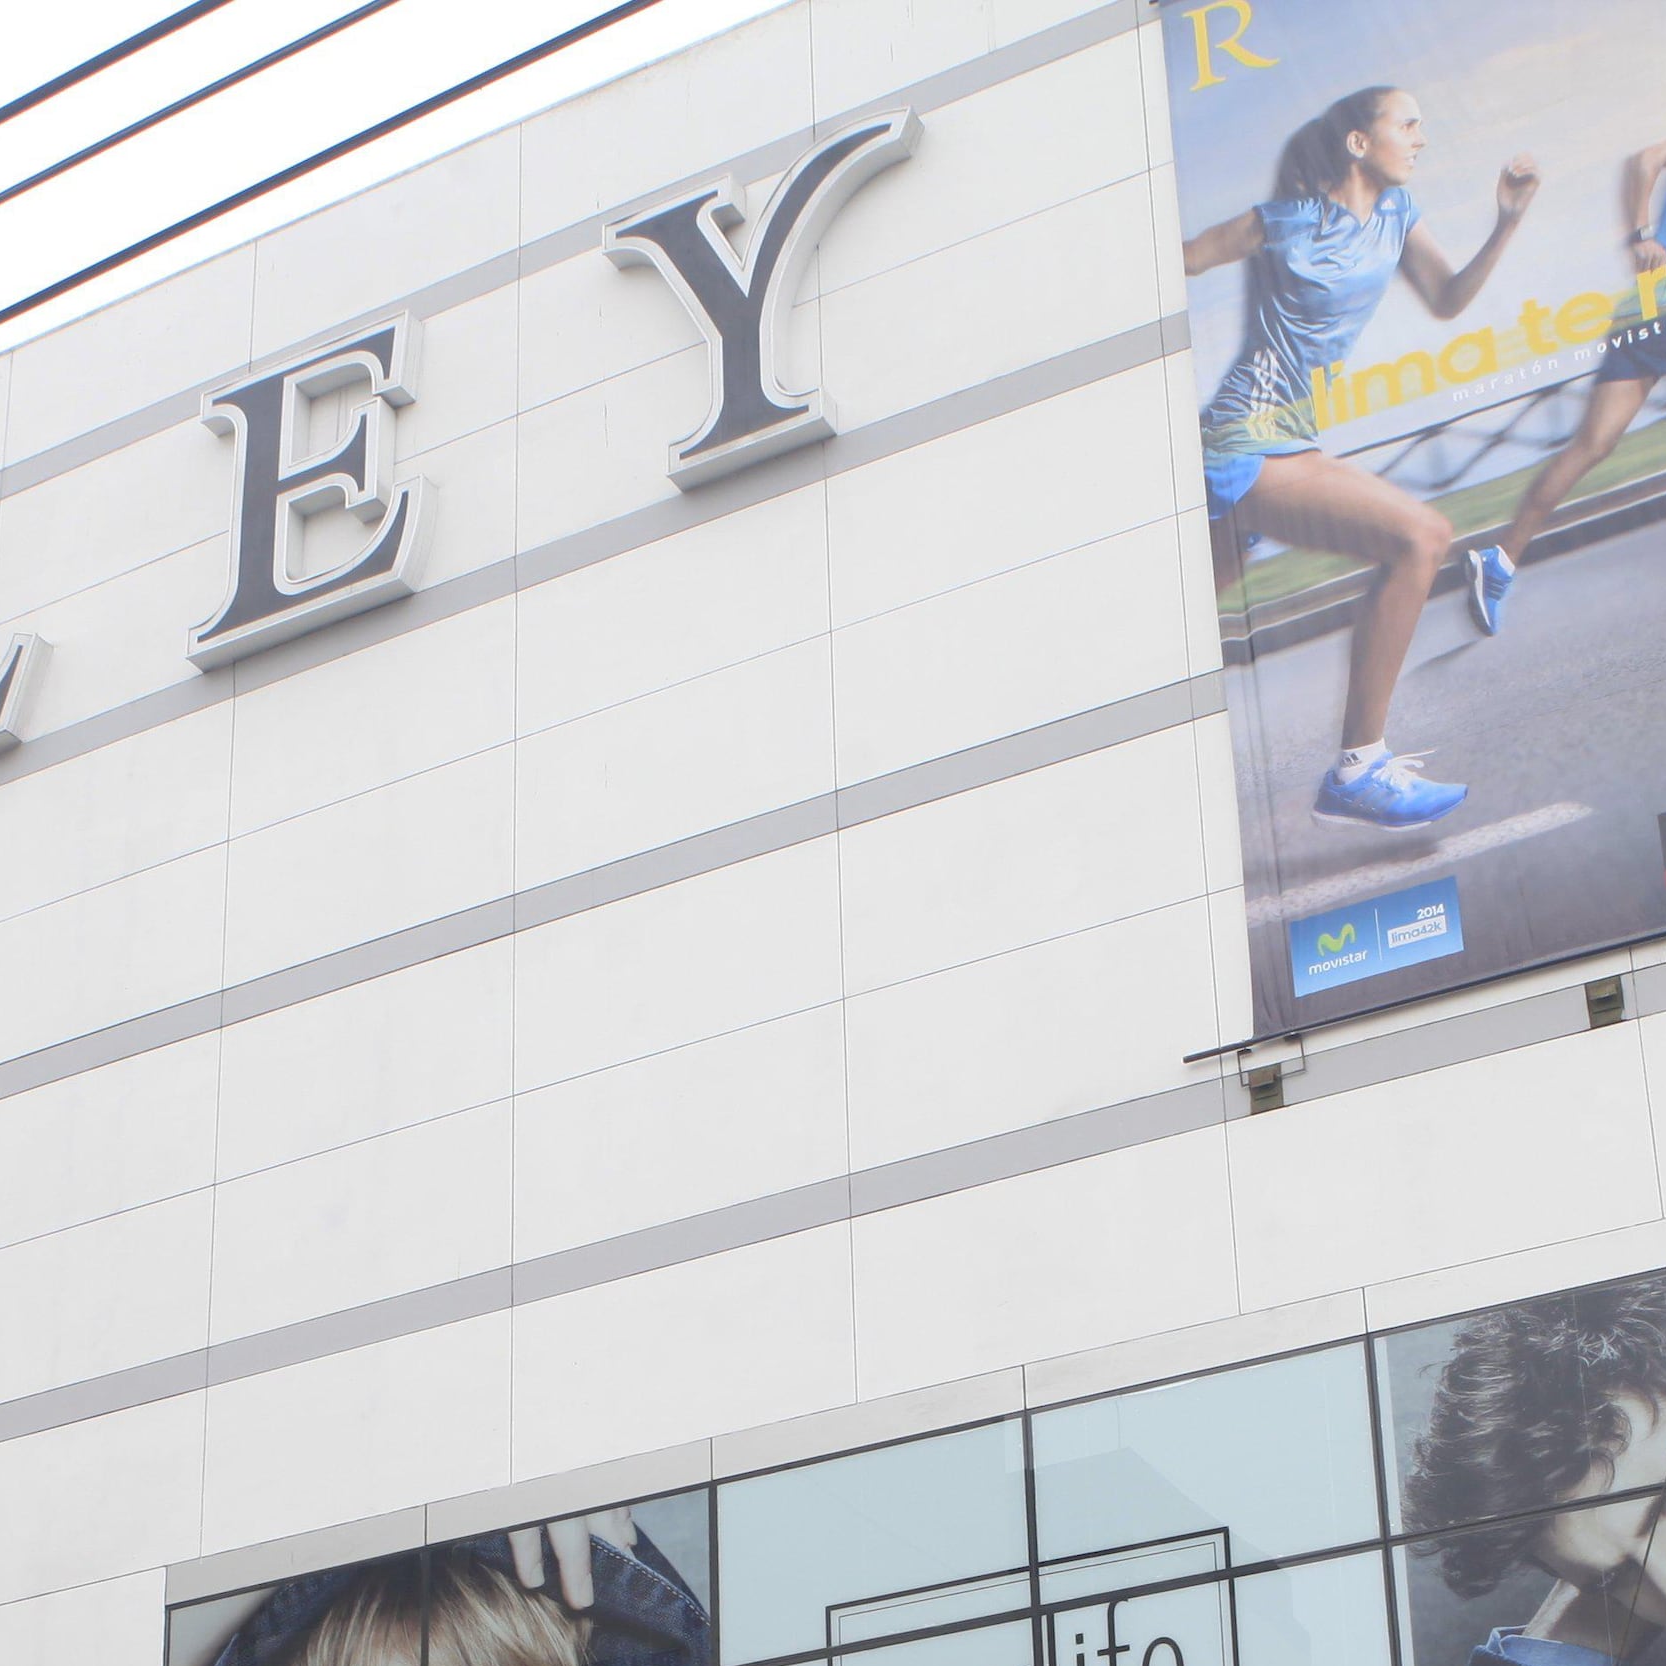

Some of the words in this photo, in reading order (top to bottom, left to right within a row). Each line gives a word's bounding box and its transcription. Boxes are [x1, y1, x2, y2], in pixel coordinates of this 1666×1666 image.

[1181, 0, 1280, 91] R
[1310, 326, 1498, 431] lima
[1518, 290, 1612, 358] te
[1452, 358, 1559, 401] maratón
[1416, 903, 1445, 920] 2014
[1391, 921, 1442, 945] lima42k
[1308, 949, 1369, 976] movistar
